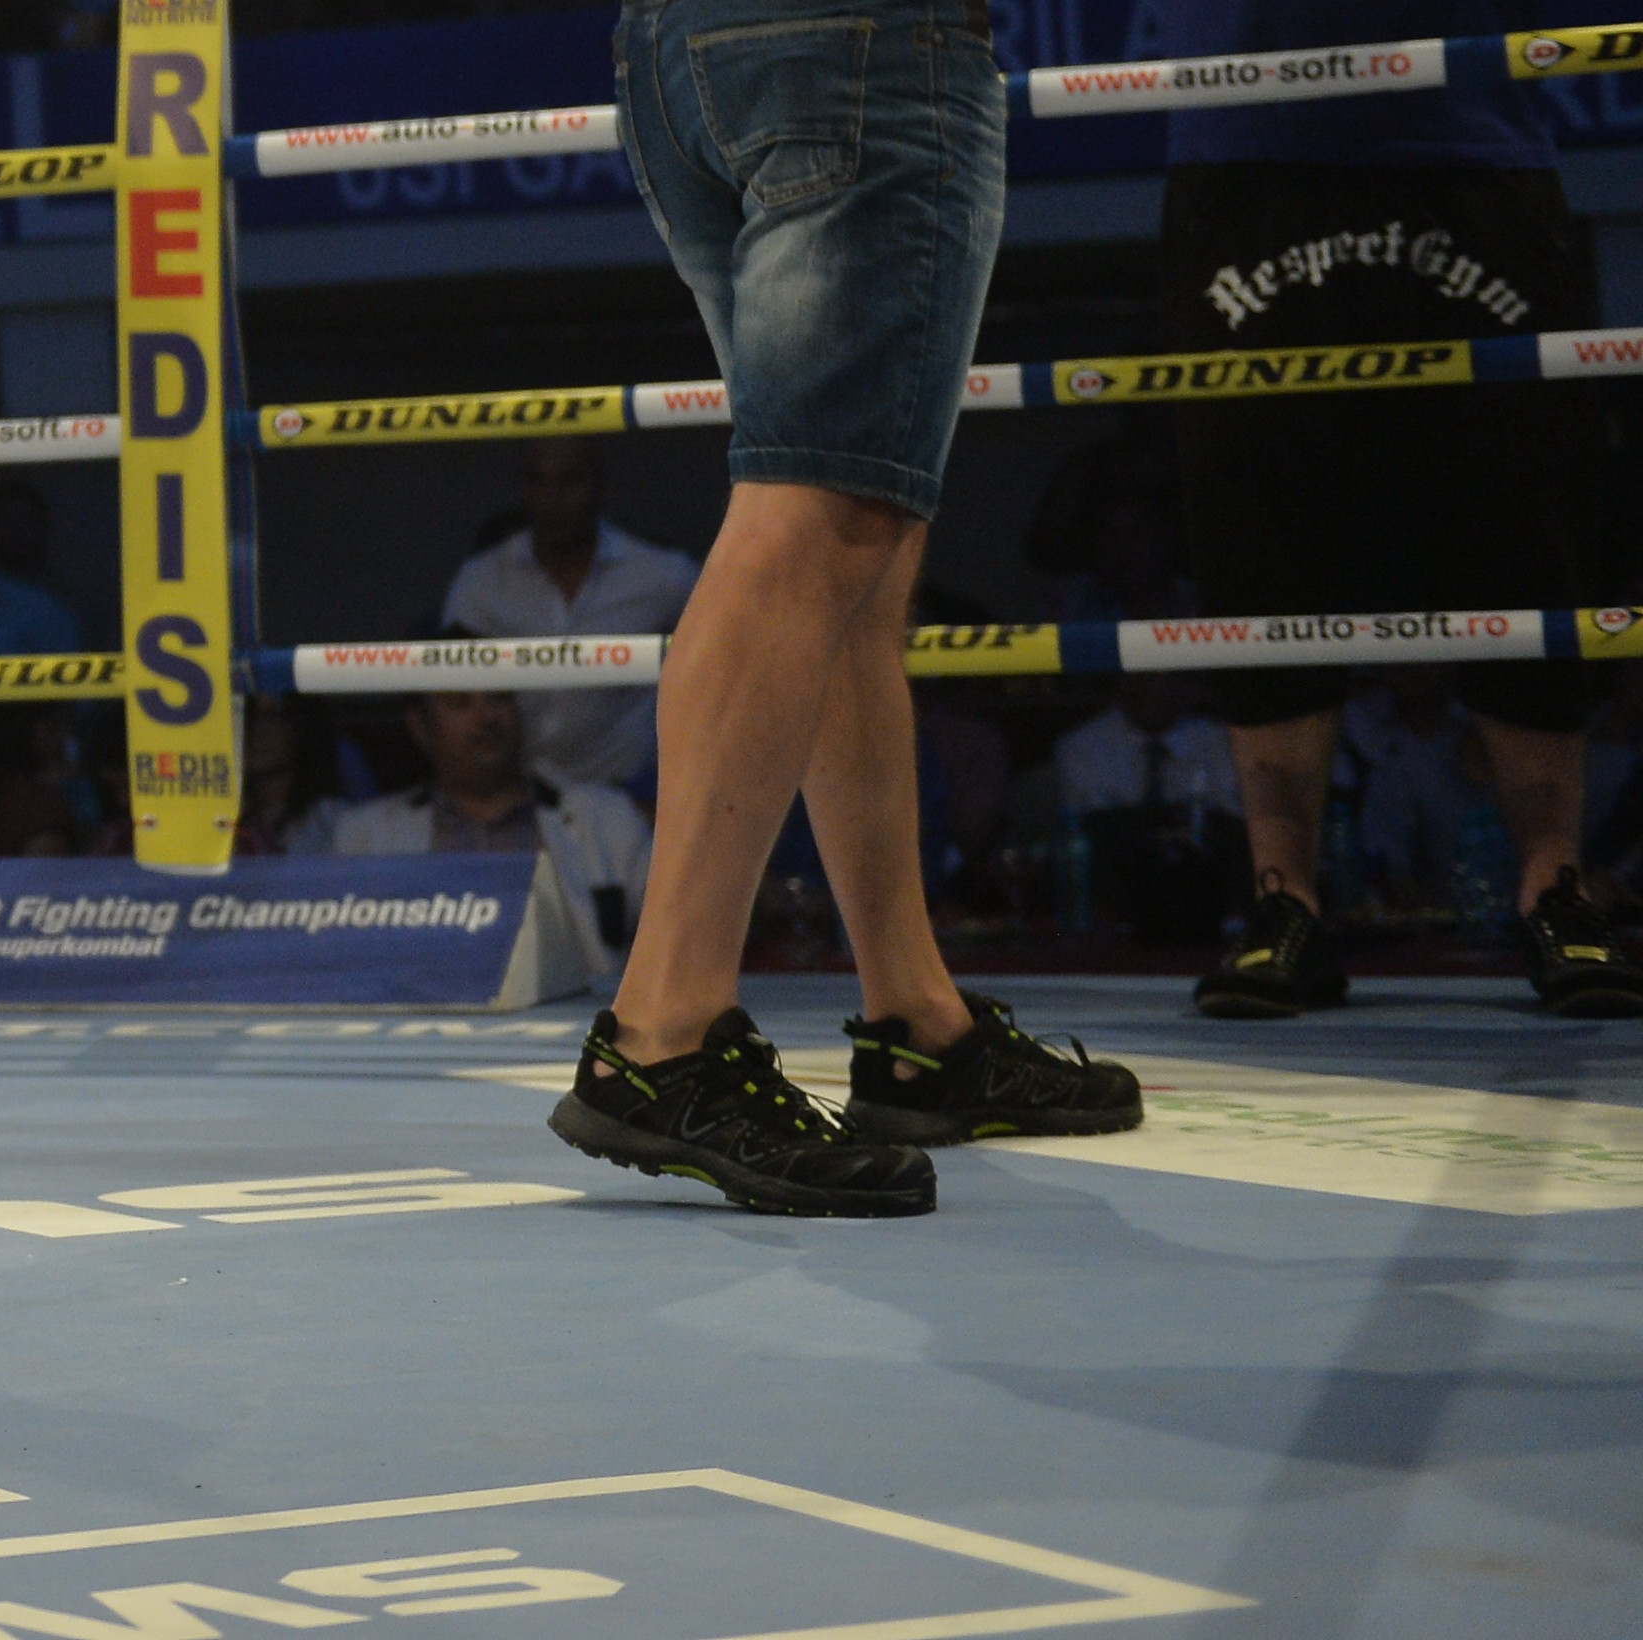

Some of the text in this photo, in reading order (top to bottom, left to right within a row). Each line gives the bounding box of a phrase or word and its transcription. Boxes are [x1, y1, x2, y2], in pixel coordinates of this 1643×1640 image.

[1062, 51, 1412, 96] www.auto-soft.ro
[286, 109, 588, 147] www.auto-soft.ro
[125, 52, 215, 726] REDIS
[1129, 345, 1454, 395] DUNLOP
[327, 395, 605, 435] DUNLOP
[1151, 615, 1509, 647] www.auto-soft.ro
[325, 642, 632, 668] www.auto-soft.ro
[8, 894, 180, 937] Fighting
[188, 891, 502, 934] Championship
